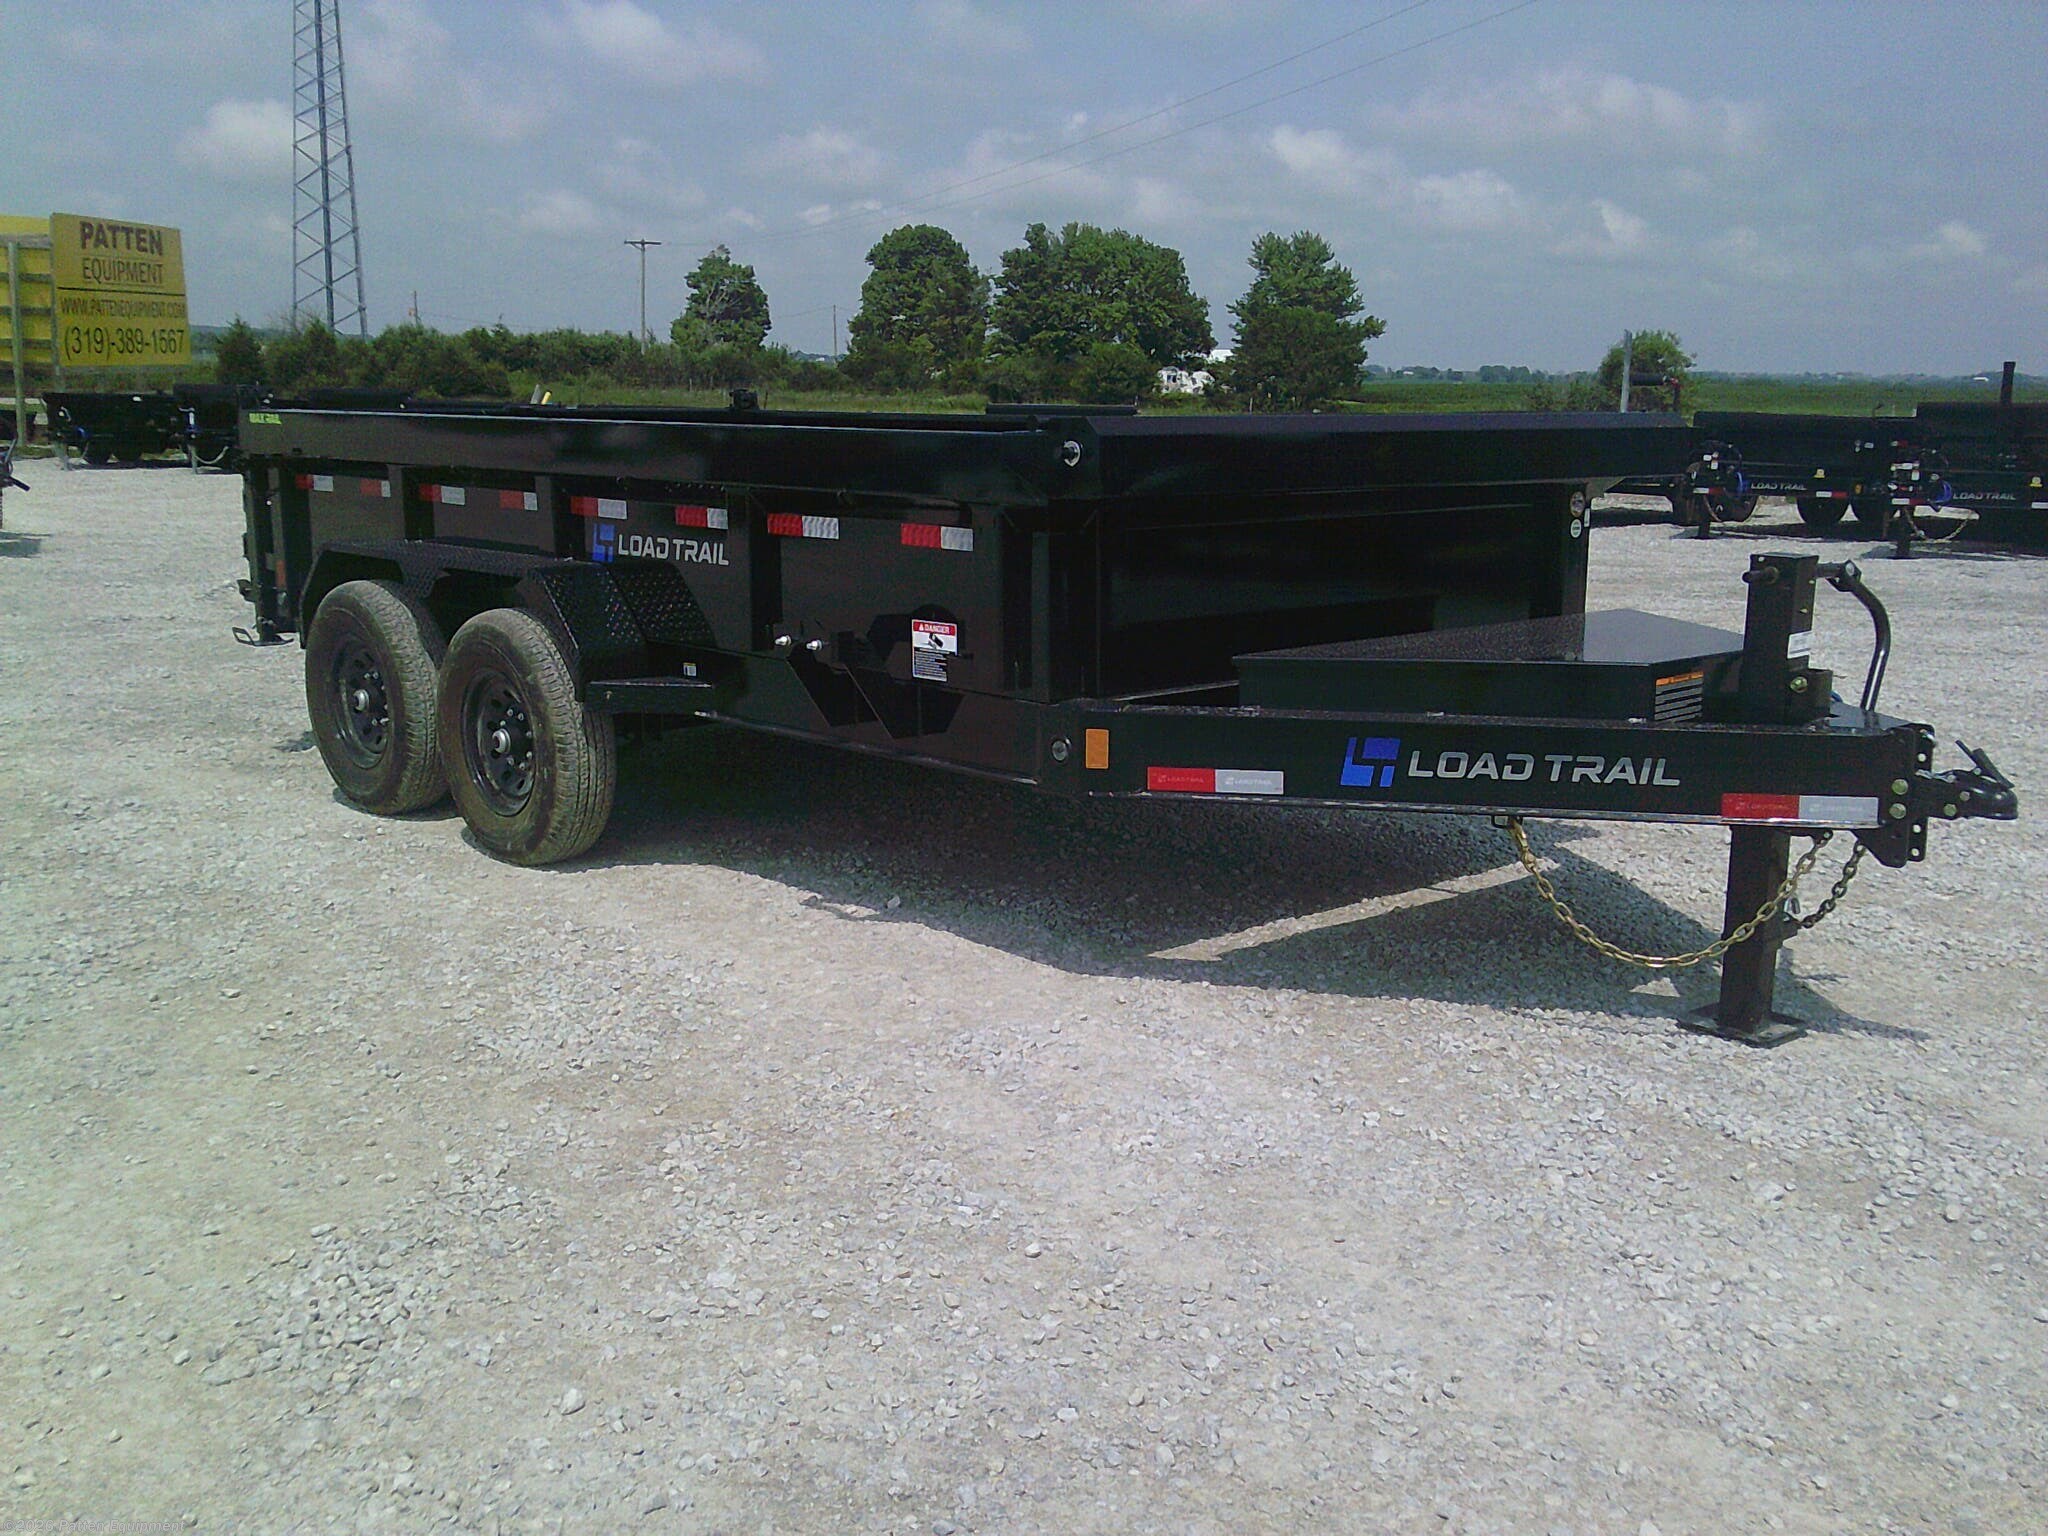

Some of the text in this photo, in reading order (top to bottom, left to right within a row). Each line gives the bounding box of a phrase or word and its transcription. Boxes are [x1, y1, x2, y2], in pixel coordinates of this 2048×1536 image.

[80, 220, 164, 256] PATTEN
[82, 258, 164, 285] EQUIPMENT
[64, 326, 185, 361] (319)-389-1567
[1952, 492, 1983, 500] LOAD
[618, 534, 730, 566] LOAD TRAIL
[1407, 750, 1682, 787] LOAD TRAIL
